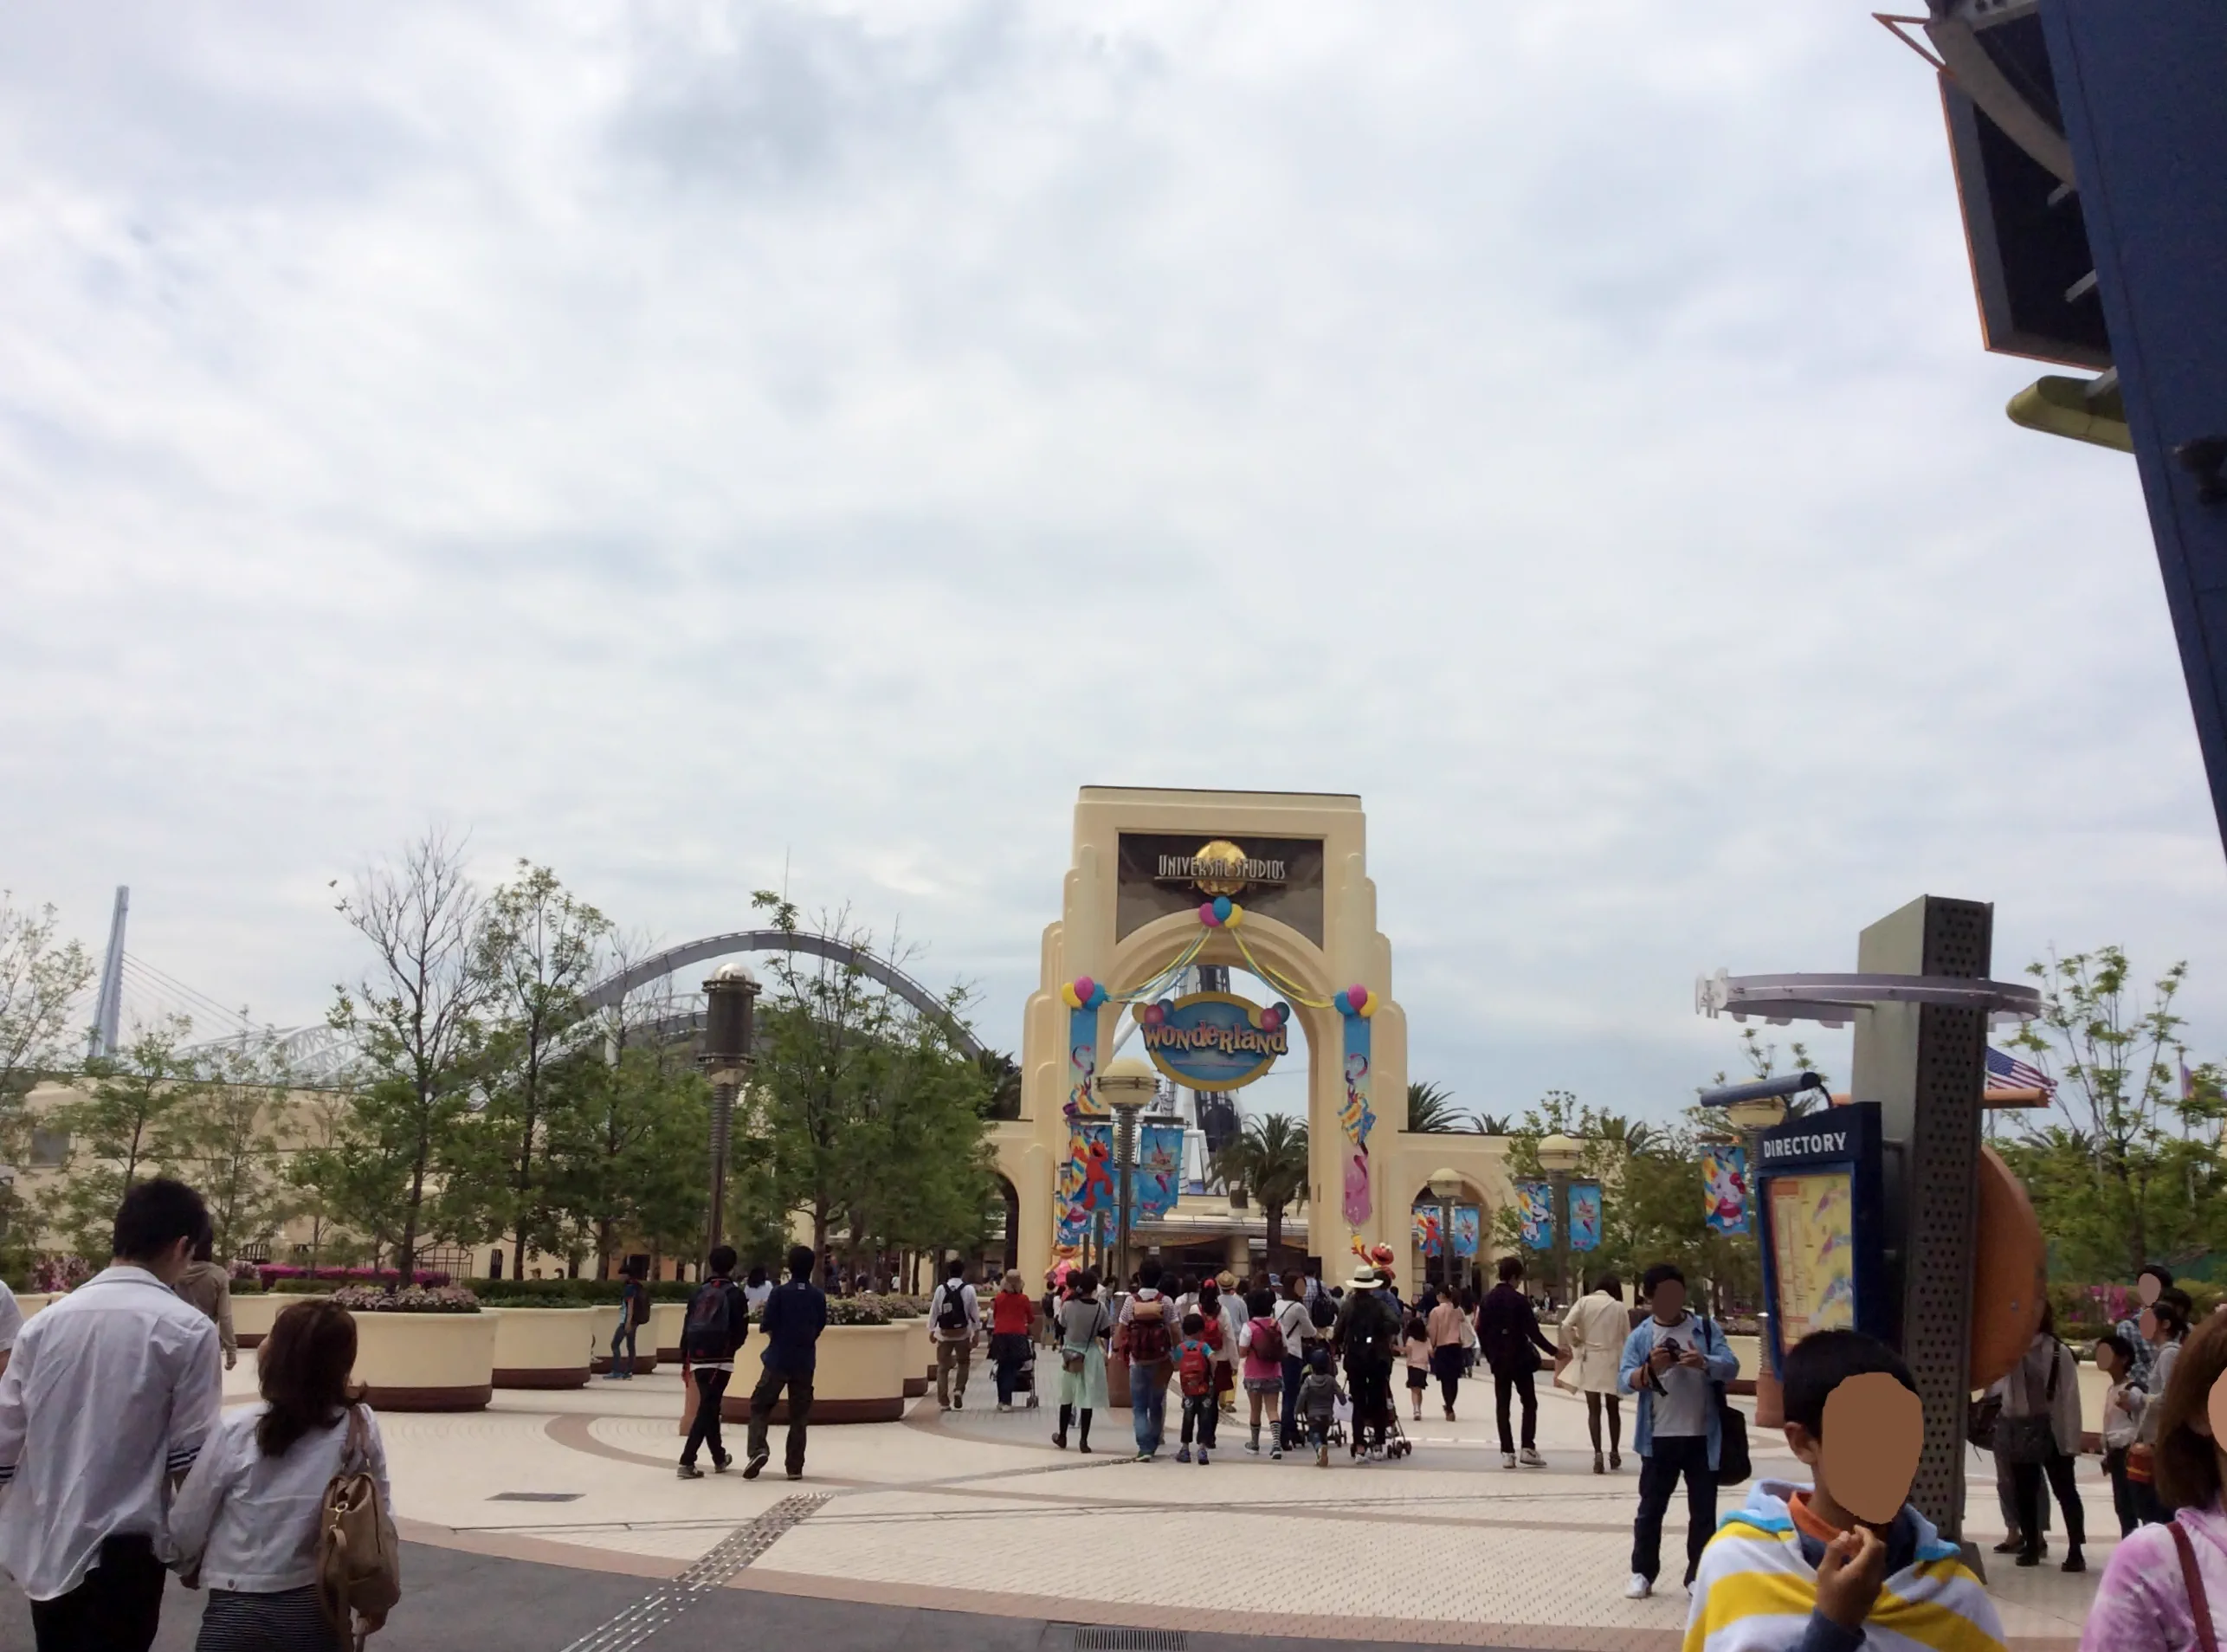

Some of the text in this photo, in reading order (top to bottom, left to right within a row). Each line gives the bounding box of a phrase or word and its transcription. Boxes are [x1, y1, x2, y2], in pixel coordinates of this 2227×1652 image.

[1158, 854, 1286, 880] UNIVERSAL STUDIOS
[1763, 1132, 1847, 1158] DIRECTORY
